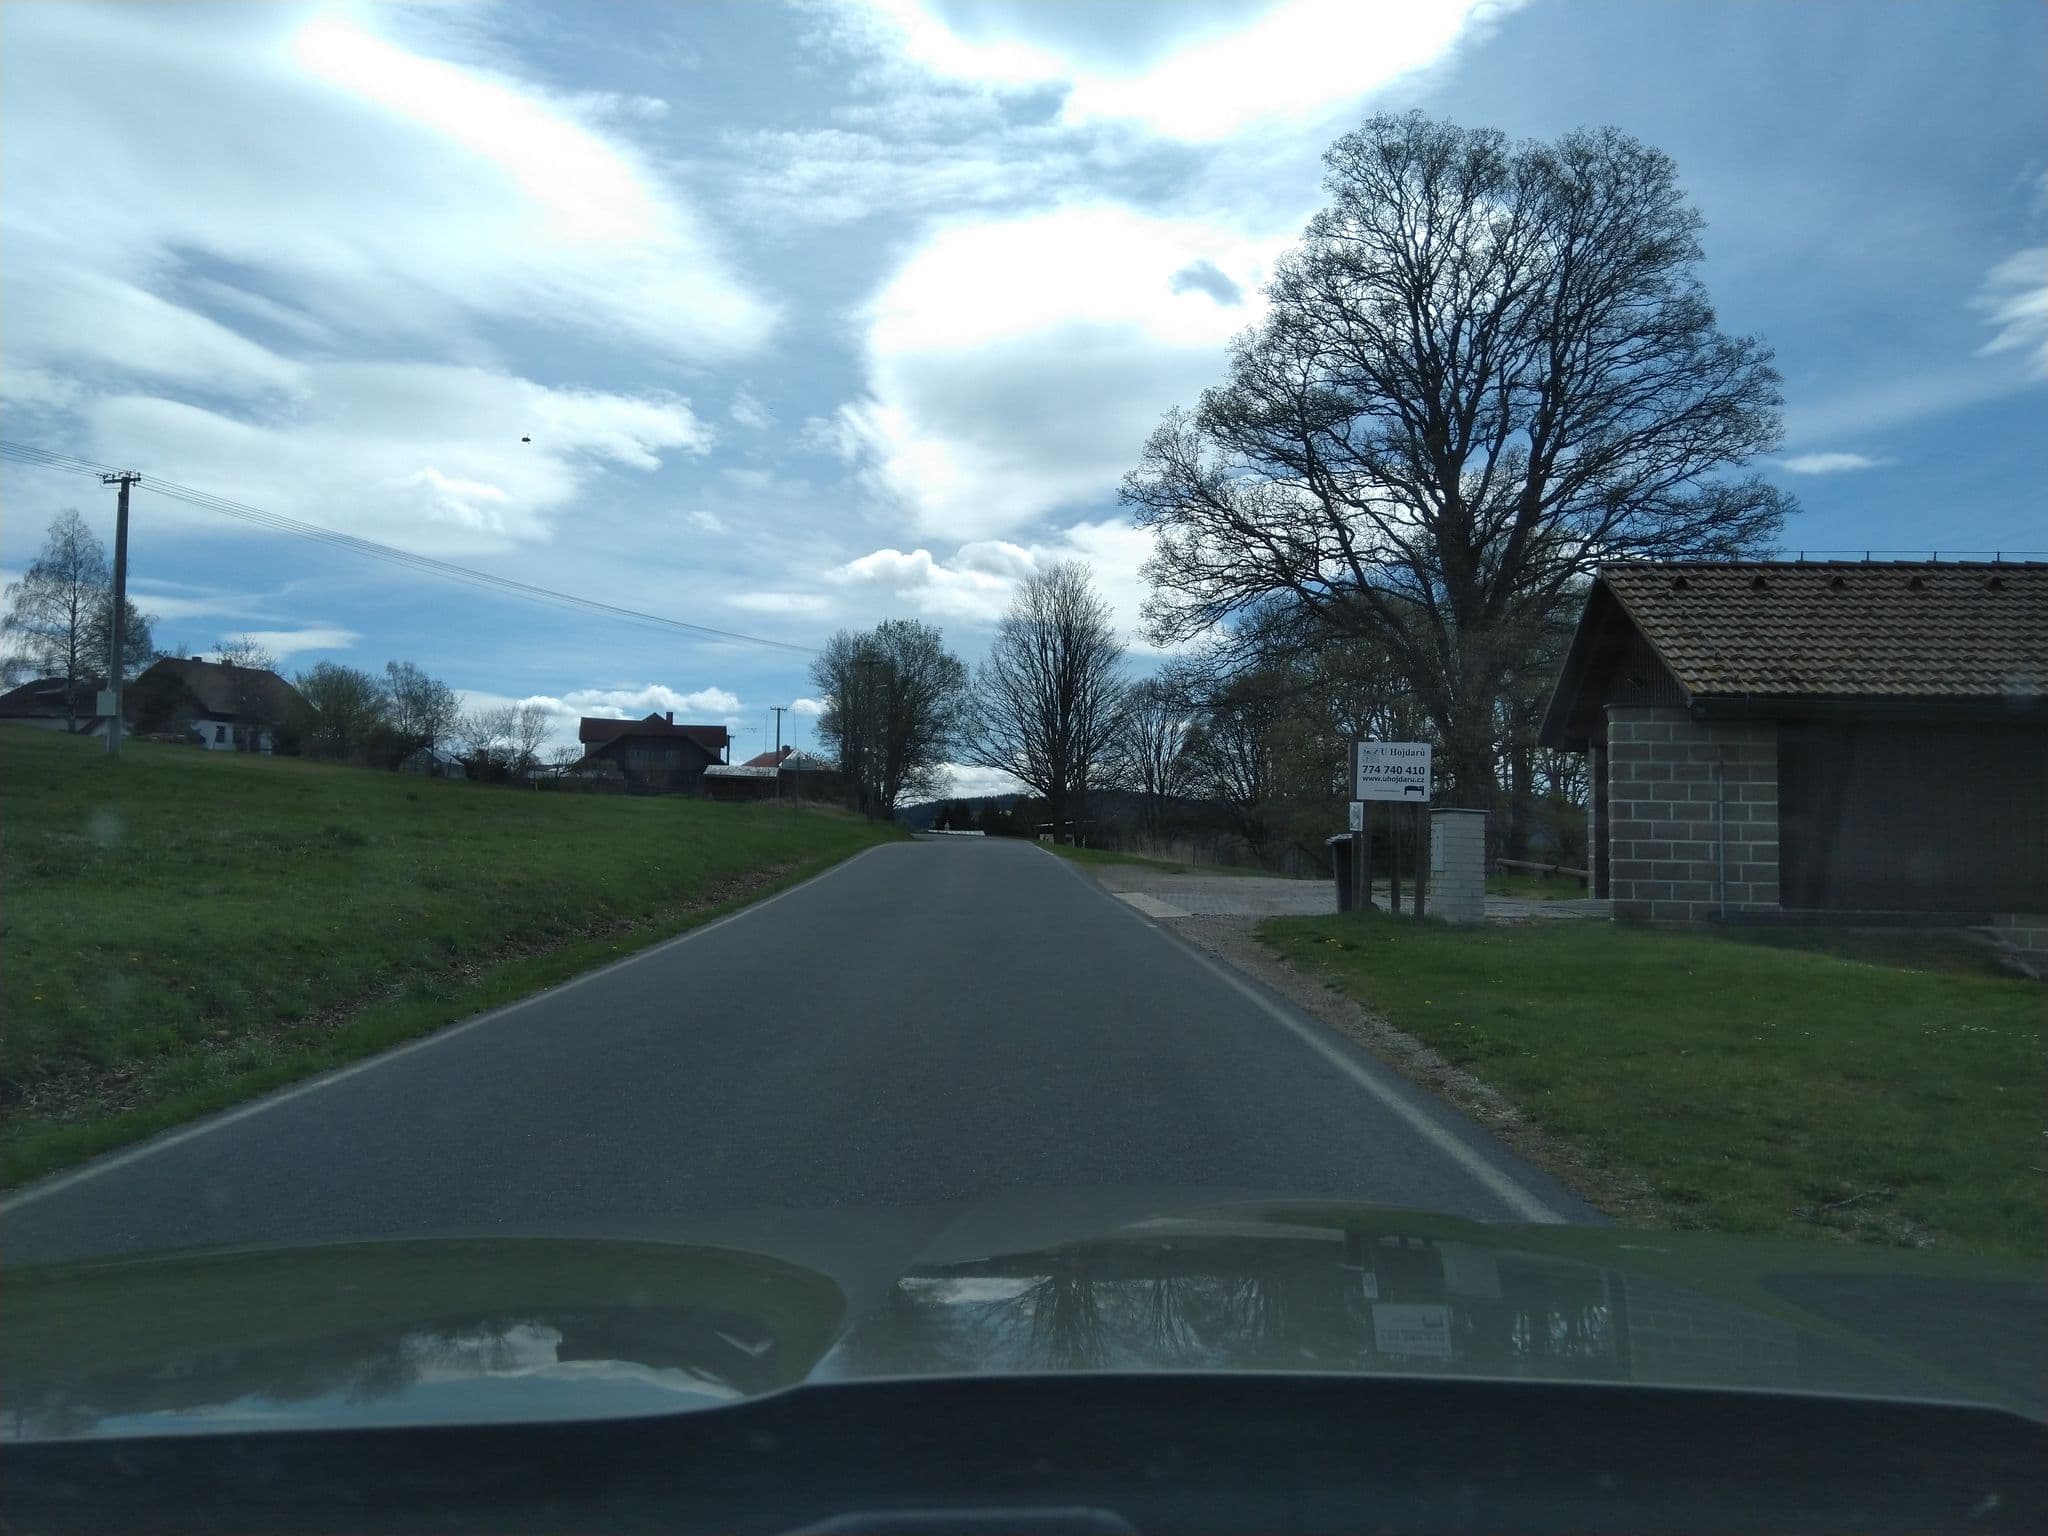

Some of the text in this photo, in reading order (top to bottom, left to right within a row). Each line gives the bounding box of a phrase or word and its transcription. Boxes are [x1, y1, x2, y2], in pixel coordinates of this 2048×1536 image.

[1362, 765, 1425, 775] 774 740 410
[1362, 776, 1425, 784] www.uhojdaru.cz
